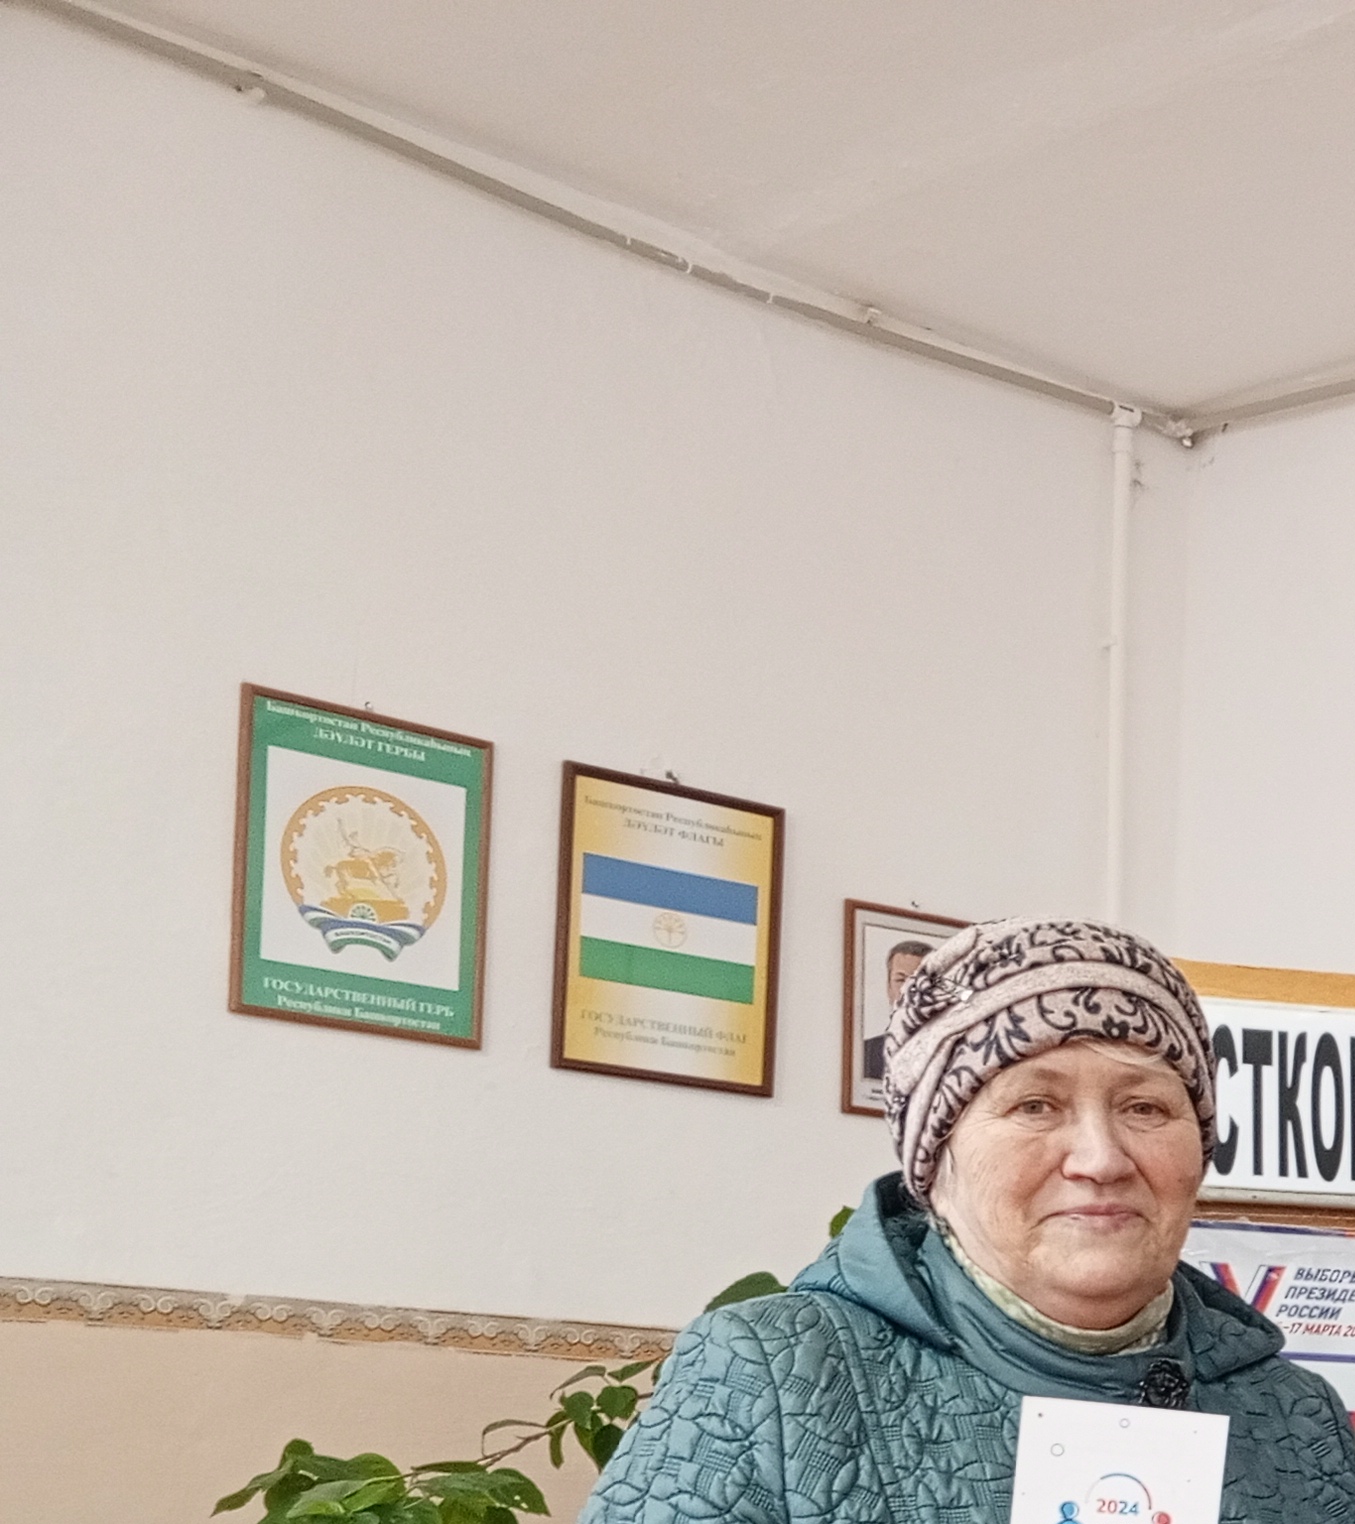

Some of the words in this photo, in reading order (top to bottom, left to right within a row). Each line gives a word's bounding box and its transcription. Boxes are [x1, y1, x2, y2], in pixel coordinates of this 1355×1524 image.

[1275, 1304, 1343, 1321] РОССИИ
[1302, 1323, 1342, 1338] МАРТА
[1097, 1498, 1140, 1516] 2024
